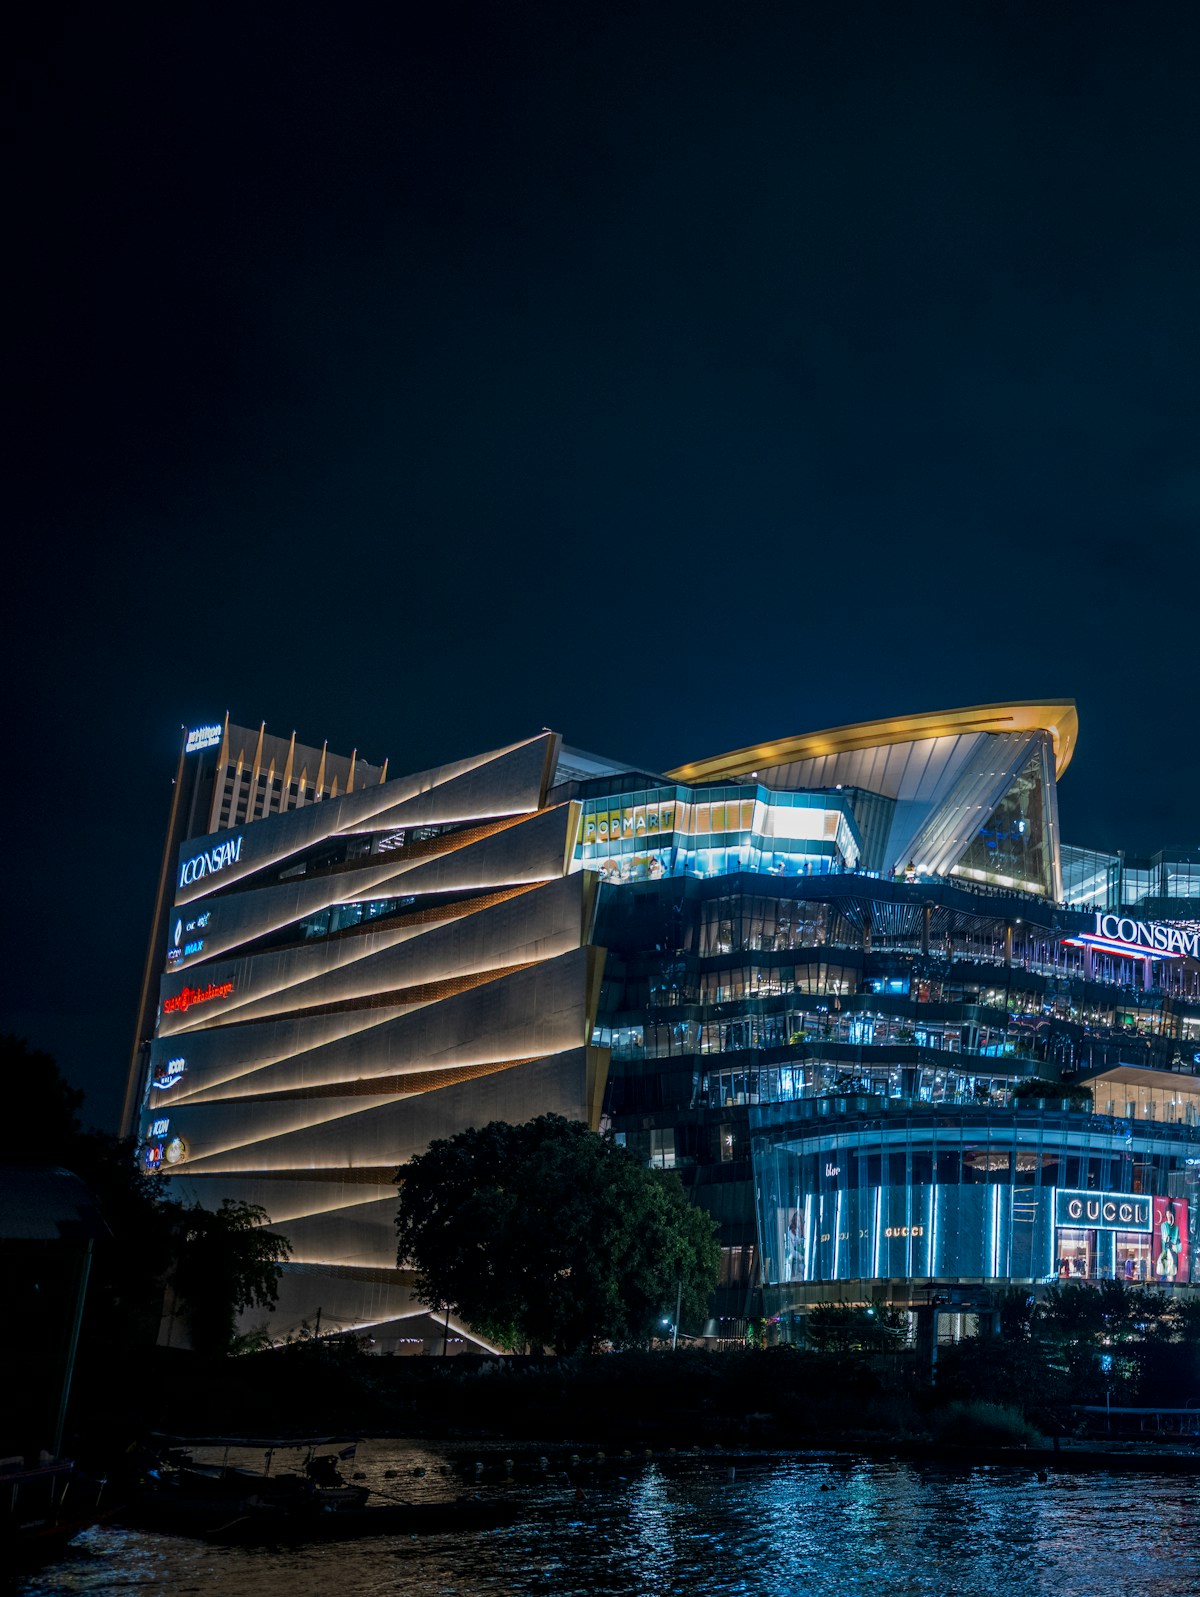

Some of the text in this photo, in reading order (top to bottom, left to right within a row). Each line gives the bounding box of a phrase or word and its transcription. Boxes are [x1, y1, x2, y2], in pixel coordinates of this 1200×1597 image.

[180, 836, 242, 888] ICONSIAM
[1094, 912, 1199, 957] ICONSIAM
[184, 941, 203, 955] IMAX
[153, 1119, 169, 1135] ICON
[1069, 1200, 1139, 1222] GUCCI
[885, 1227, 924, 1237] GUCCI
